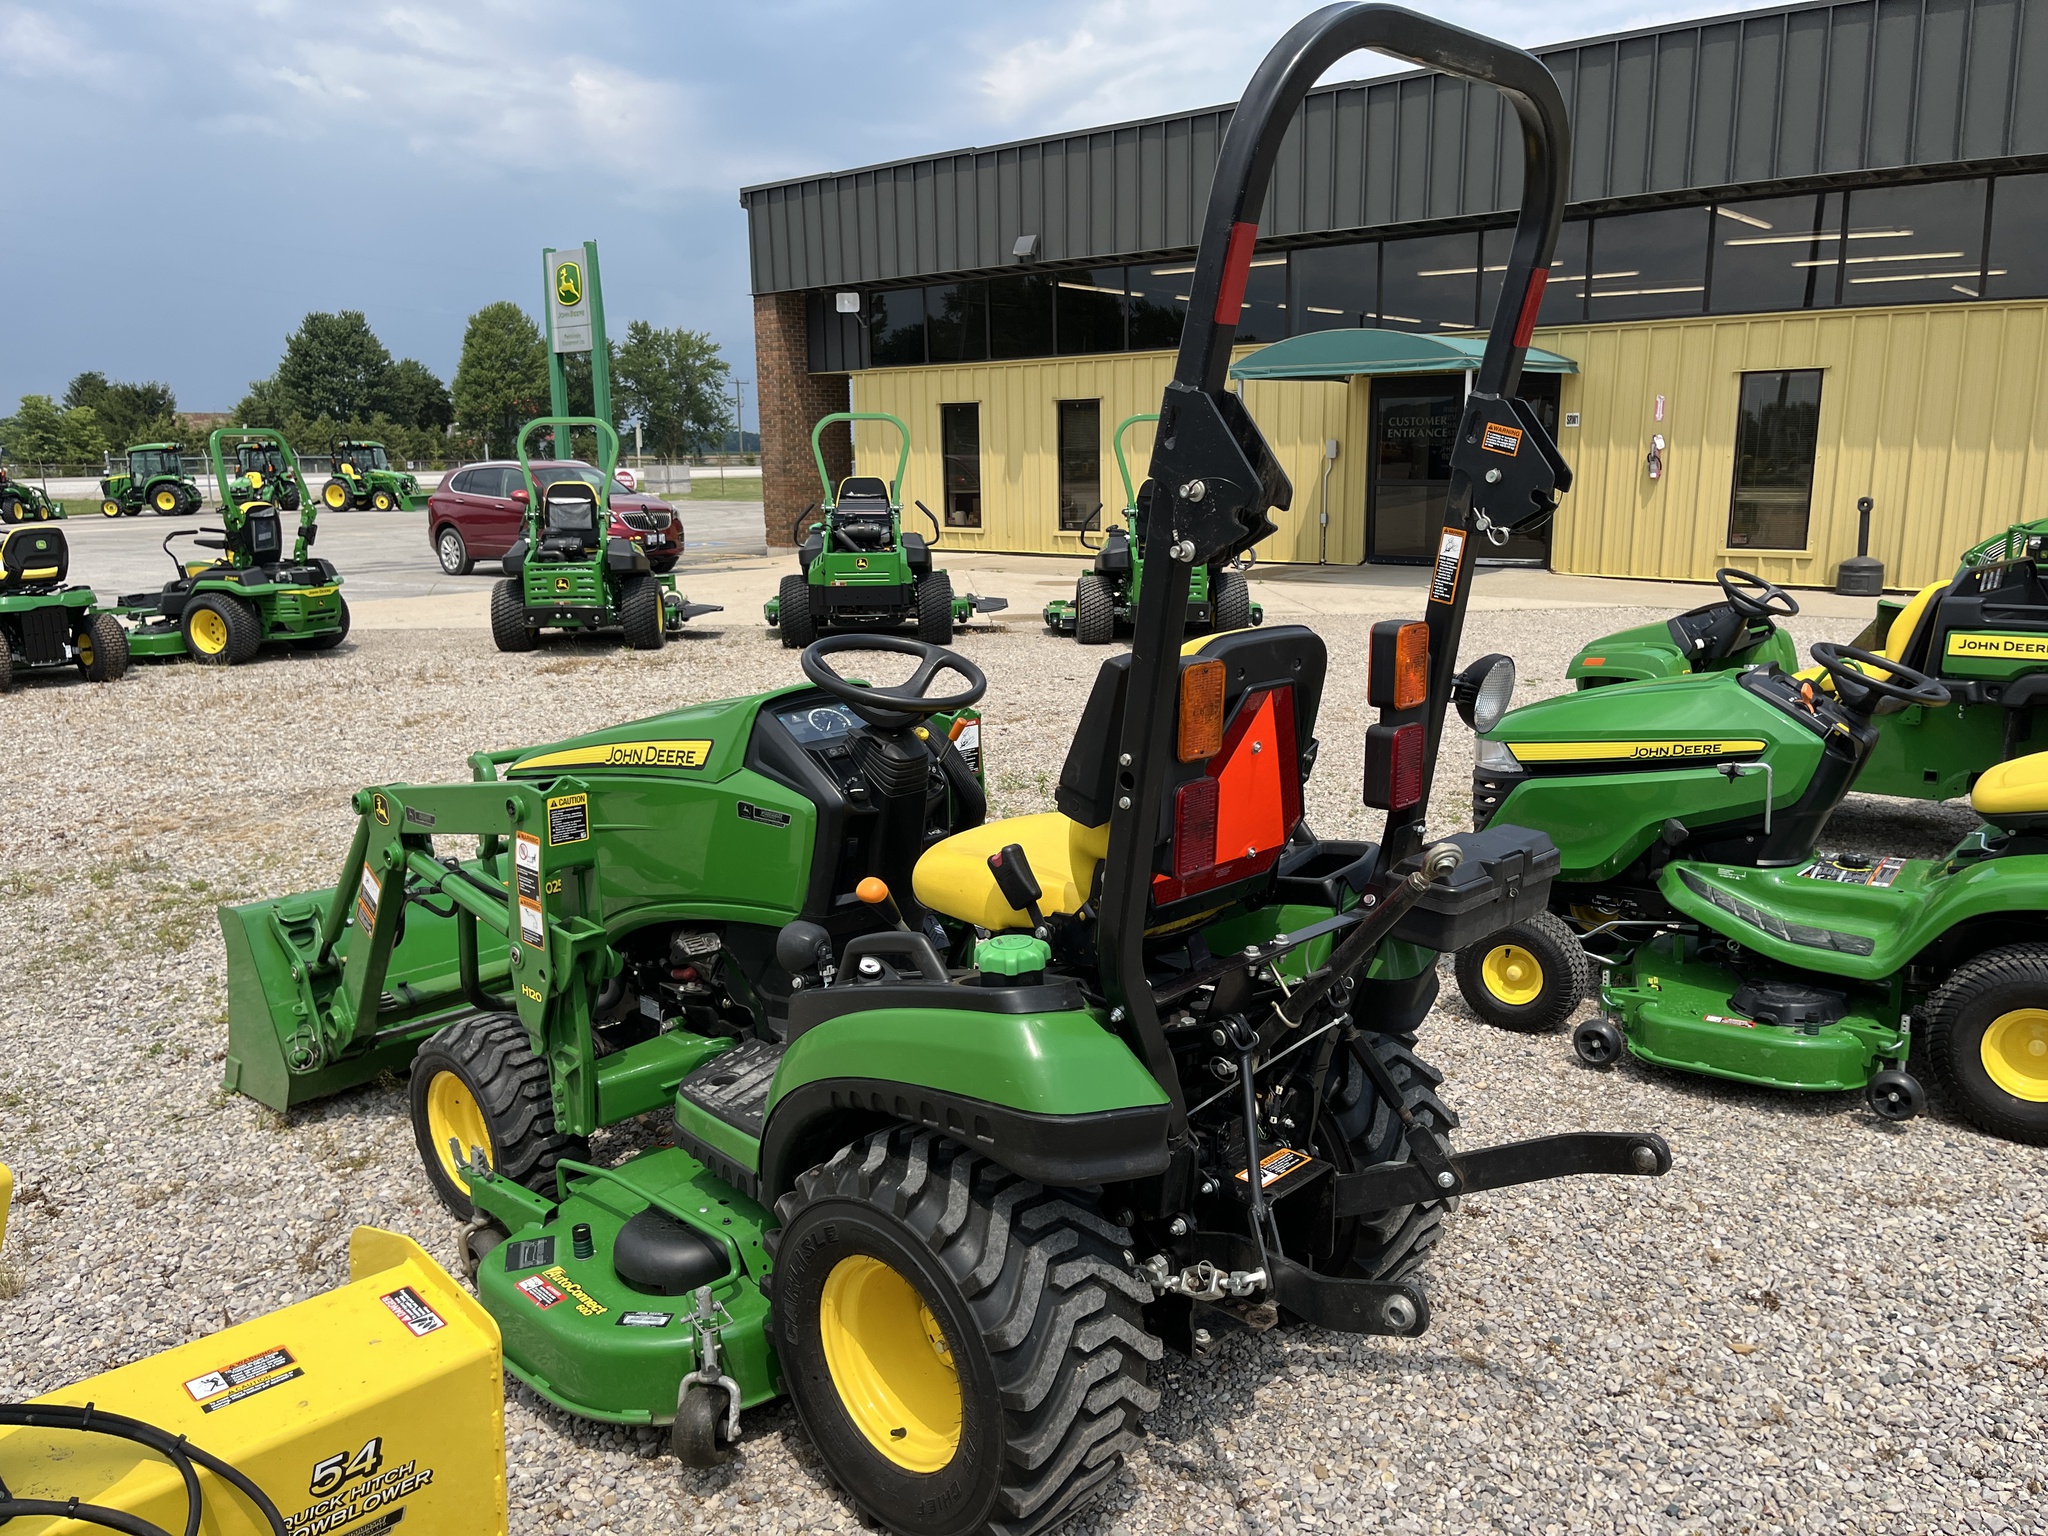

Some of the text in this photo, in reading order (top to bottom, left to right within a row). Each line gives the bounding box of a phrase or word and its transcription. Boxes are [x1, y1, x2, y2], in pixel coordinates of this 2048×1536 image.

[1388, 416, 1448, 427] CUSTOMER
[1387, 428, 1448, 438] ENTRANCE
[1493, 425, 1520, 437] WARNING
[1958, 639, 2048, 653] JOHN DEER
[605, 746, 697, 764] JOHN DEERE
[1630, 743, 1722, 757] JOHN DEERE
[558, 795, 586, 806] CAUTION
[521, 983, 542, 1003] H120
[543, 1267, 609, 1316] AutoConnect
[784, 1223, 840, 1346] CARLISLE
[381, 1294, 407, 1318] DANGER
[235, 1348, 275, 1367] WARNING
[235, 1374, 272, 1392] CAUTION
[308, 1436, 384, 1498] 54
[282, 1490, 350, 1531] QUICK
[350, 1459, 417, 1502] HITCH
[287, 1468, 434, 1536] OWBLOWER
